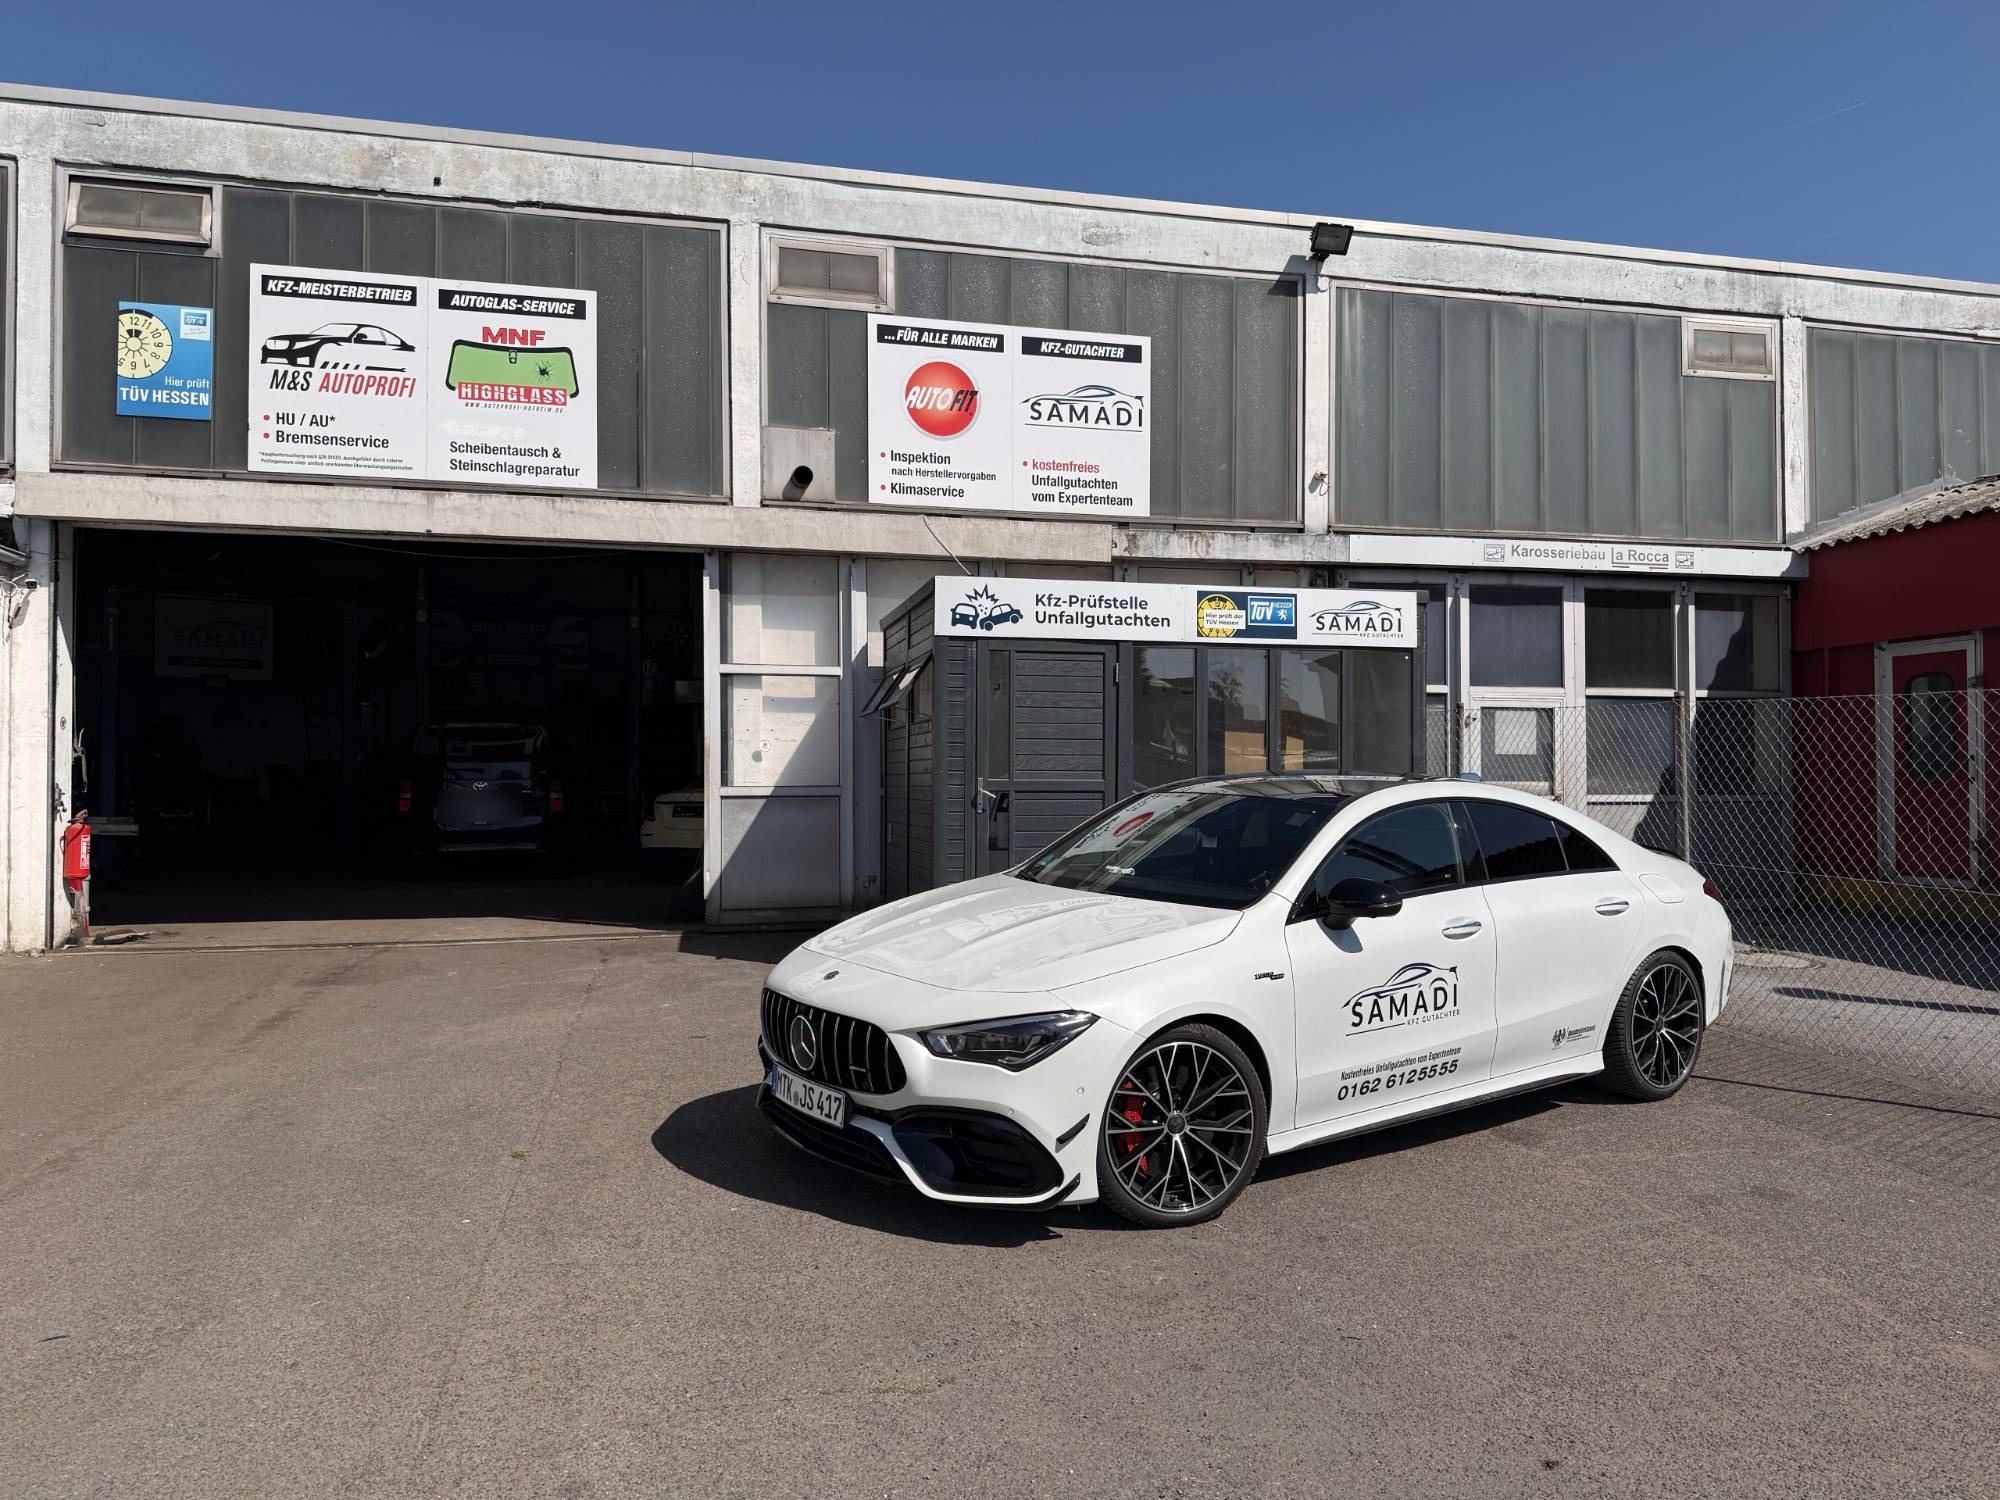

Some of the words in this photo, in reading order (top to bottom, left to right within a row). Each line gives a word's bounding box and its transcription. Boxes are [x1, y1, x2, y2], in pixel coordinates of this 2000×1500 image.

[267, 279, 413, 302] KFZ-MEISTERBETRIEB
[450, 294, 576, 315] AUTOGLAS-SERVICE
[129, 316, 140, 326] 12
[482, 326, 546, 347] MNF
[920, 331, 949, 345] ALLE
[950, 334, 999, 349] MARKEN
[1040, 341, 1125, 359] KFZ-GUTACHTER
[164, 376, 184, 387] Hier
[186, 378, 210, 390] prüft
[269, 369, 313, 392] M&S
[318, 372, 417, 398] AUTOPROFI
[119, 385, 150, 402] TÜV
[152, 389, 209, 406] HESSEN
[275, 412, 296, 426] HU
[1030, 400, 1143, 428] SAMADI
[275, 430, 390, 449] Bremsenservice
[449, 441, 549, 458] Scheibentausch
[552, 447, 562, 459] &
[890, 450, 951, 465] Inspektion
[449, 458, 580, 477] Steinschlagreparatur
[891, 467, 913, 477] nach
[915, 468, 997, 482] Herstellervorgaben
[1032, 459, 1100, 474] kostenfreies
[890, 482, 965, 498] Klimaservice
[1031, 474, 1118, 490] Unfallgutachten
[1031, 492, 1055, 503] vom
[1058, 491, 1133, 507] Expertenteam
[1511, 544, 1606, 561] Karosseriebau
[1628, 549, 1669, 563] Rocca
[1035, 593, 1149, 610] Kfz-Prüfstelle
[1035, 611, 1171, 629] Unfallgutachten
[1218, 612, 1232, 621] prüft
[1250, 601, 1274, 621] TÜV
[1206, 618, 1217, 626] TÜV
[1315, 614, 1402, 633] SAMADI
[1351, 983, 1458, 1028] SAMADI
[1407, 1016, 1420, 1026] KFZ
[1421, 1009, 1461, 1023] GUTACHTER
[1340, 1065, 1375, 1081] Kostenfreies
[1375, 1056, 1417, 1074] Unfallgutachten
[1337, 1077, 1382, 1101] 0162
[1386, 1059, 1459, 1089] 6125555
[800, 1084, 815, 1111] JS
[816, 1090, 842, 1121] 417
